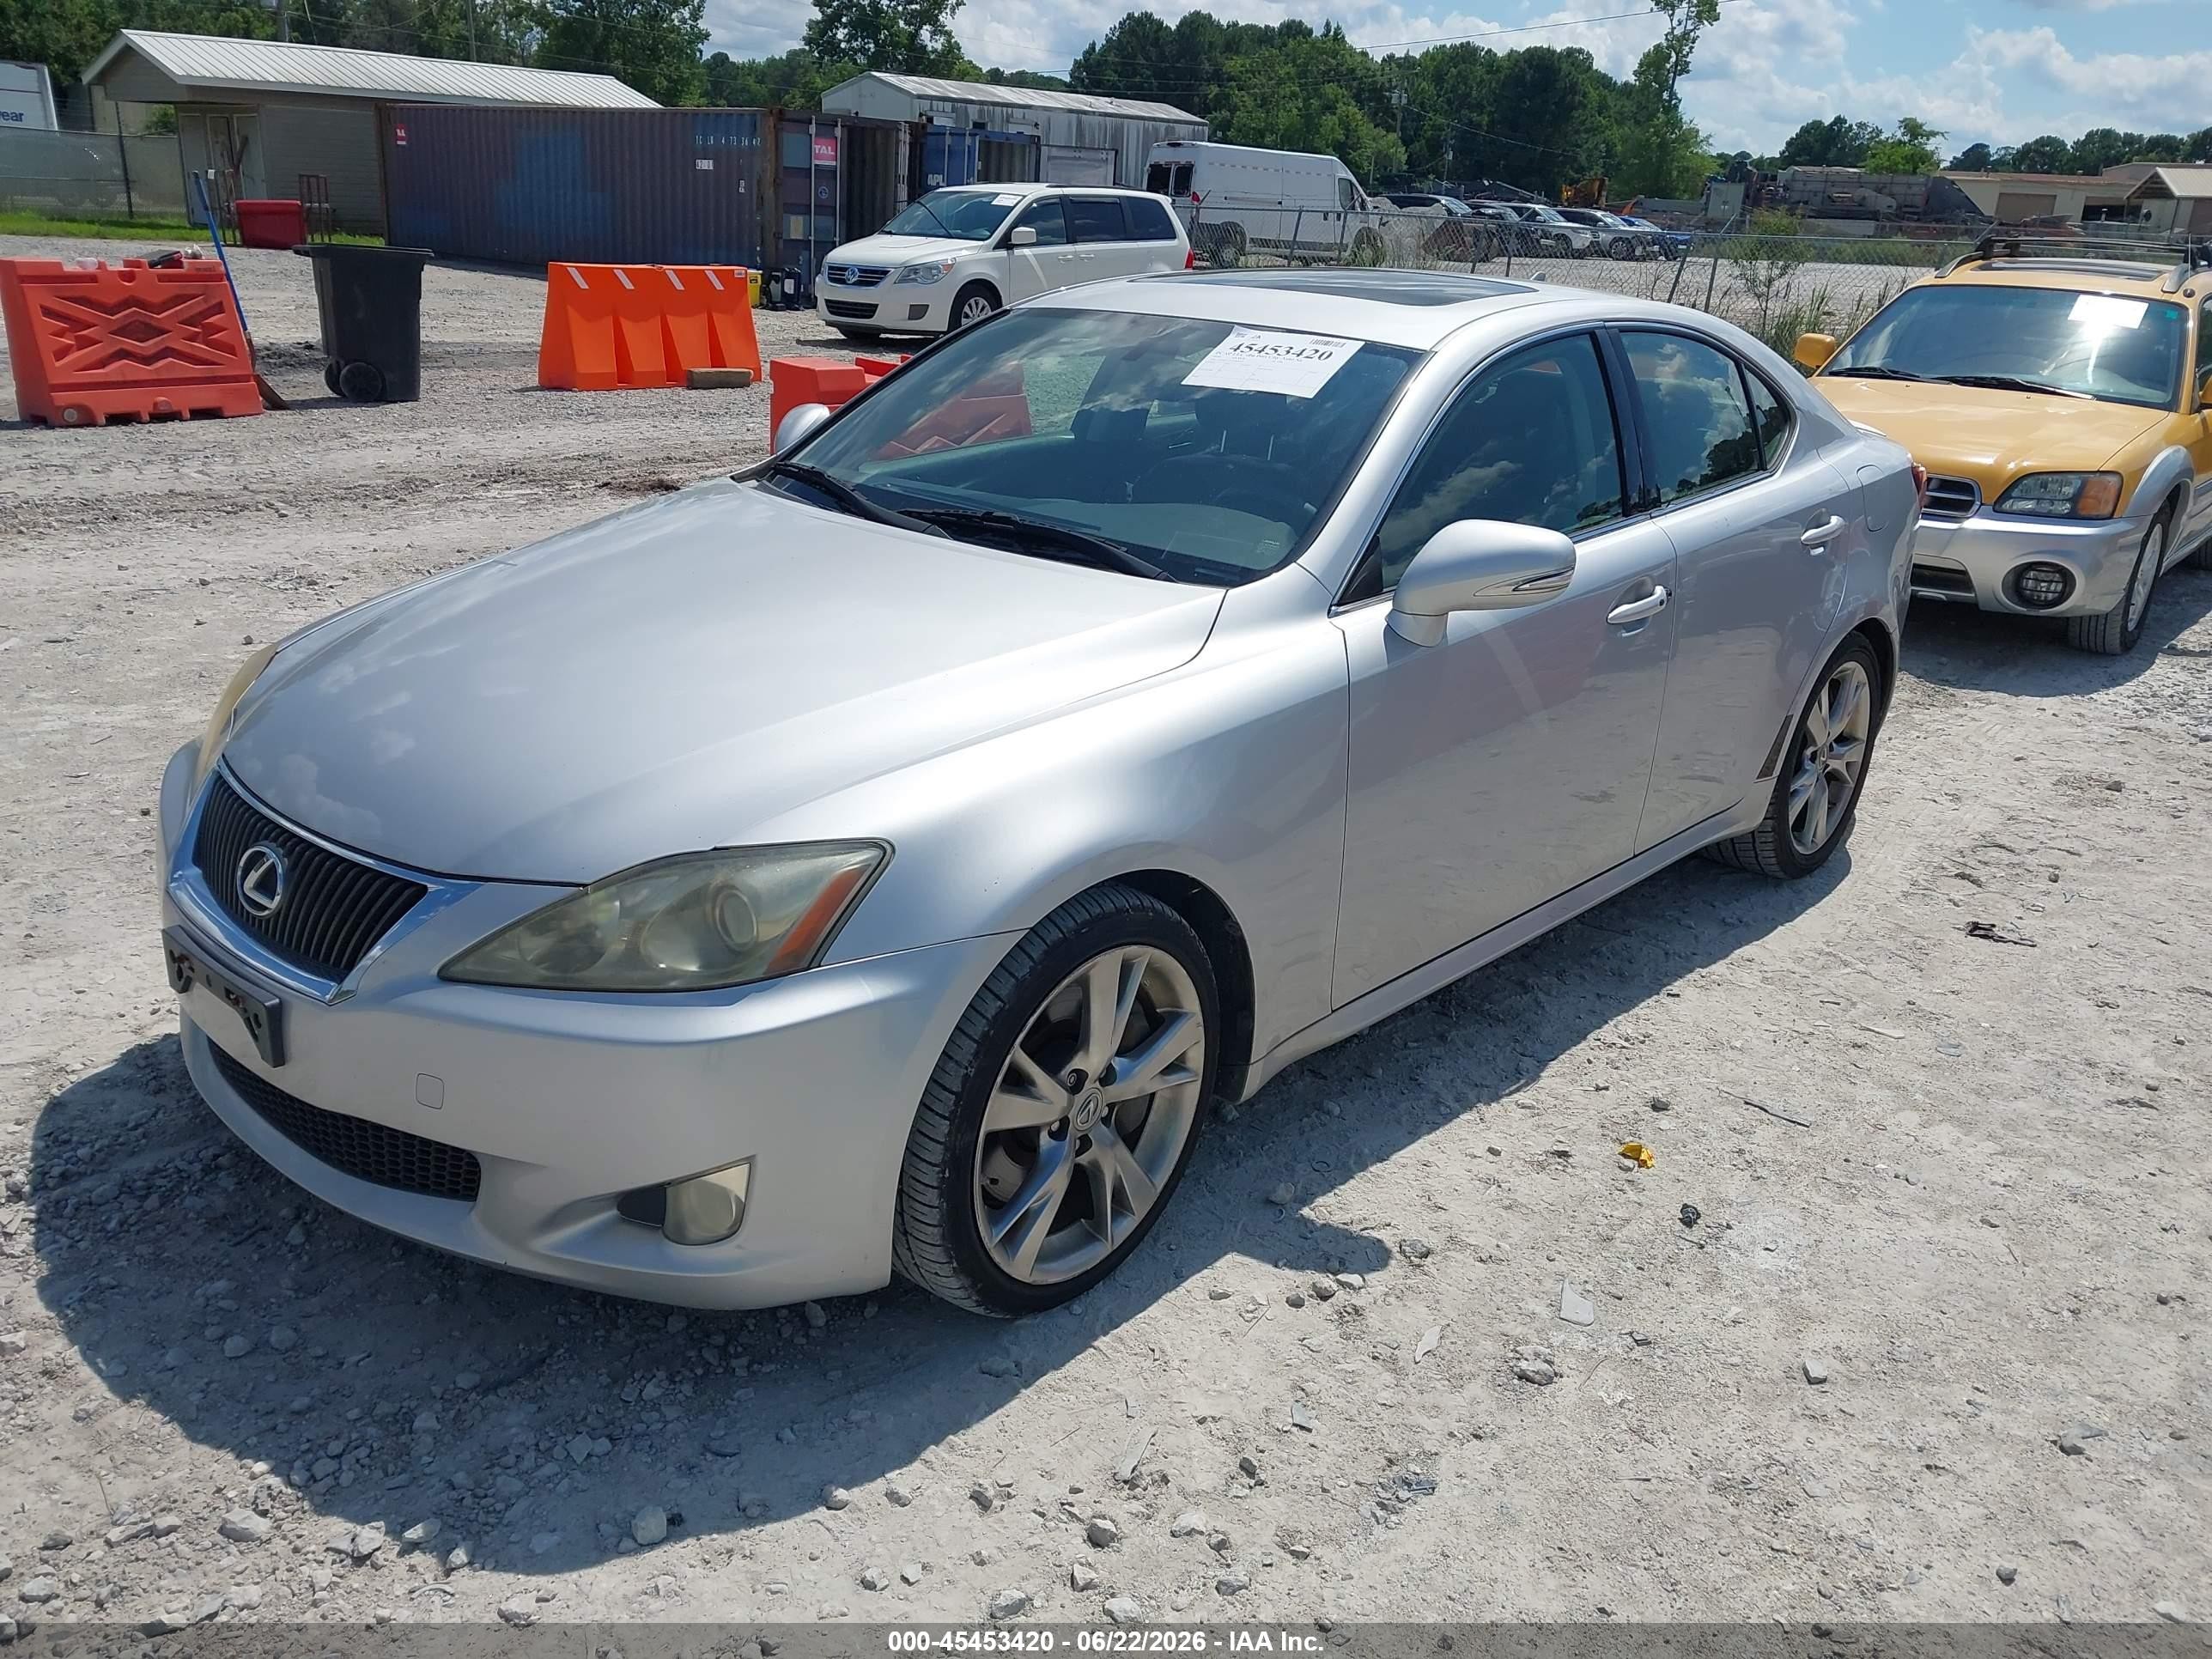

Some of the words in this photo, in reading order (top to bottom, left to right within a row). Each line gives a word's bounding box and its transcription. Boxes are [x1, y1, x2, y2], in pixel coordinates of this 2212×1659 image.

[0, 111, 24, 123] ear
[814, 144, 835, 155] TAL
[927, 173, 945, 186] APL
[1230, 342, 1334, 362] 45453420
